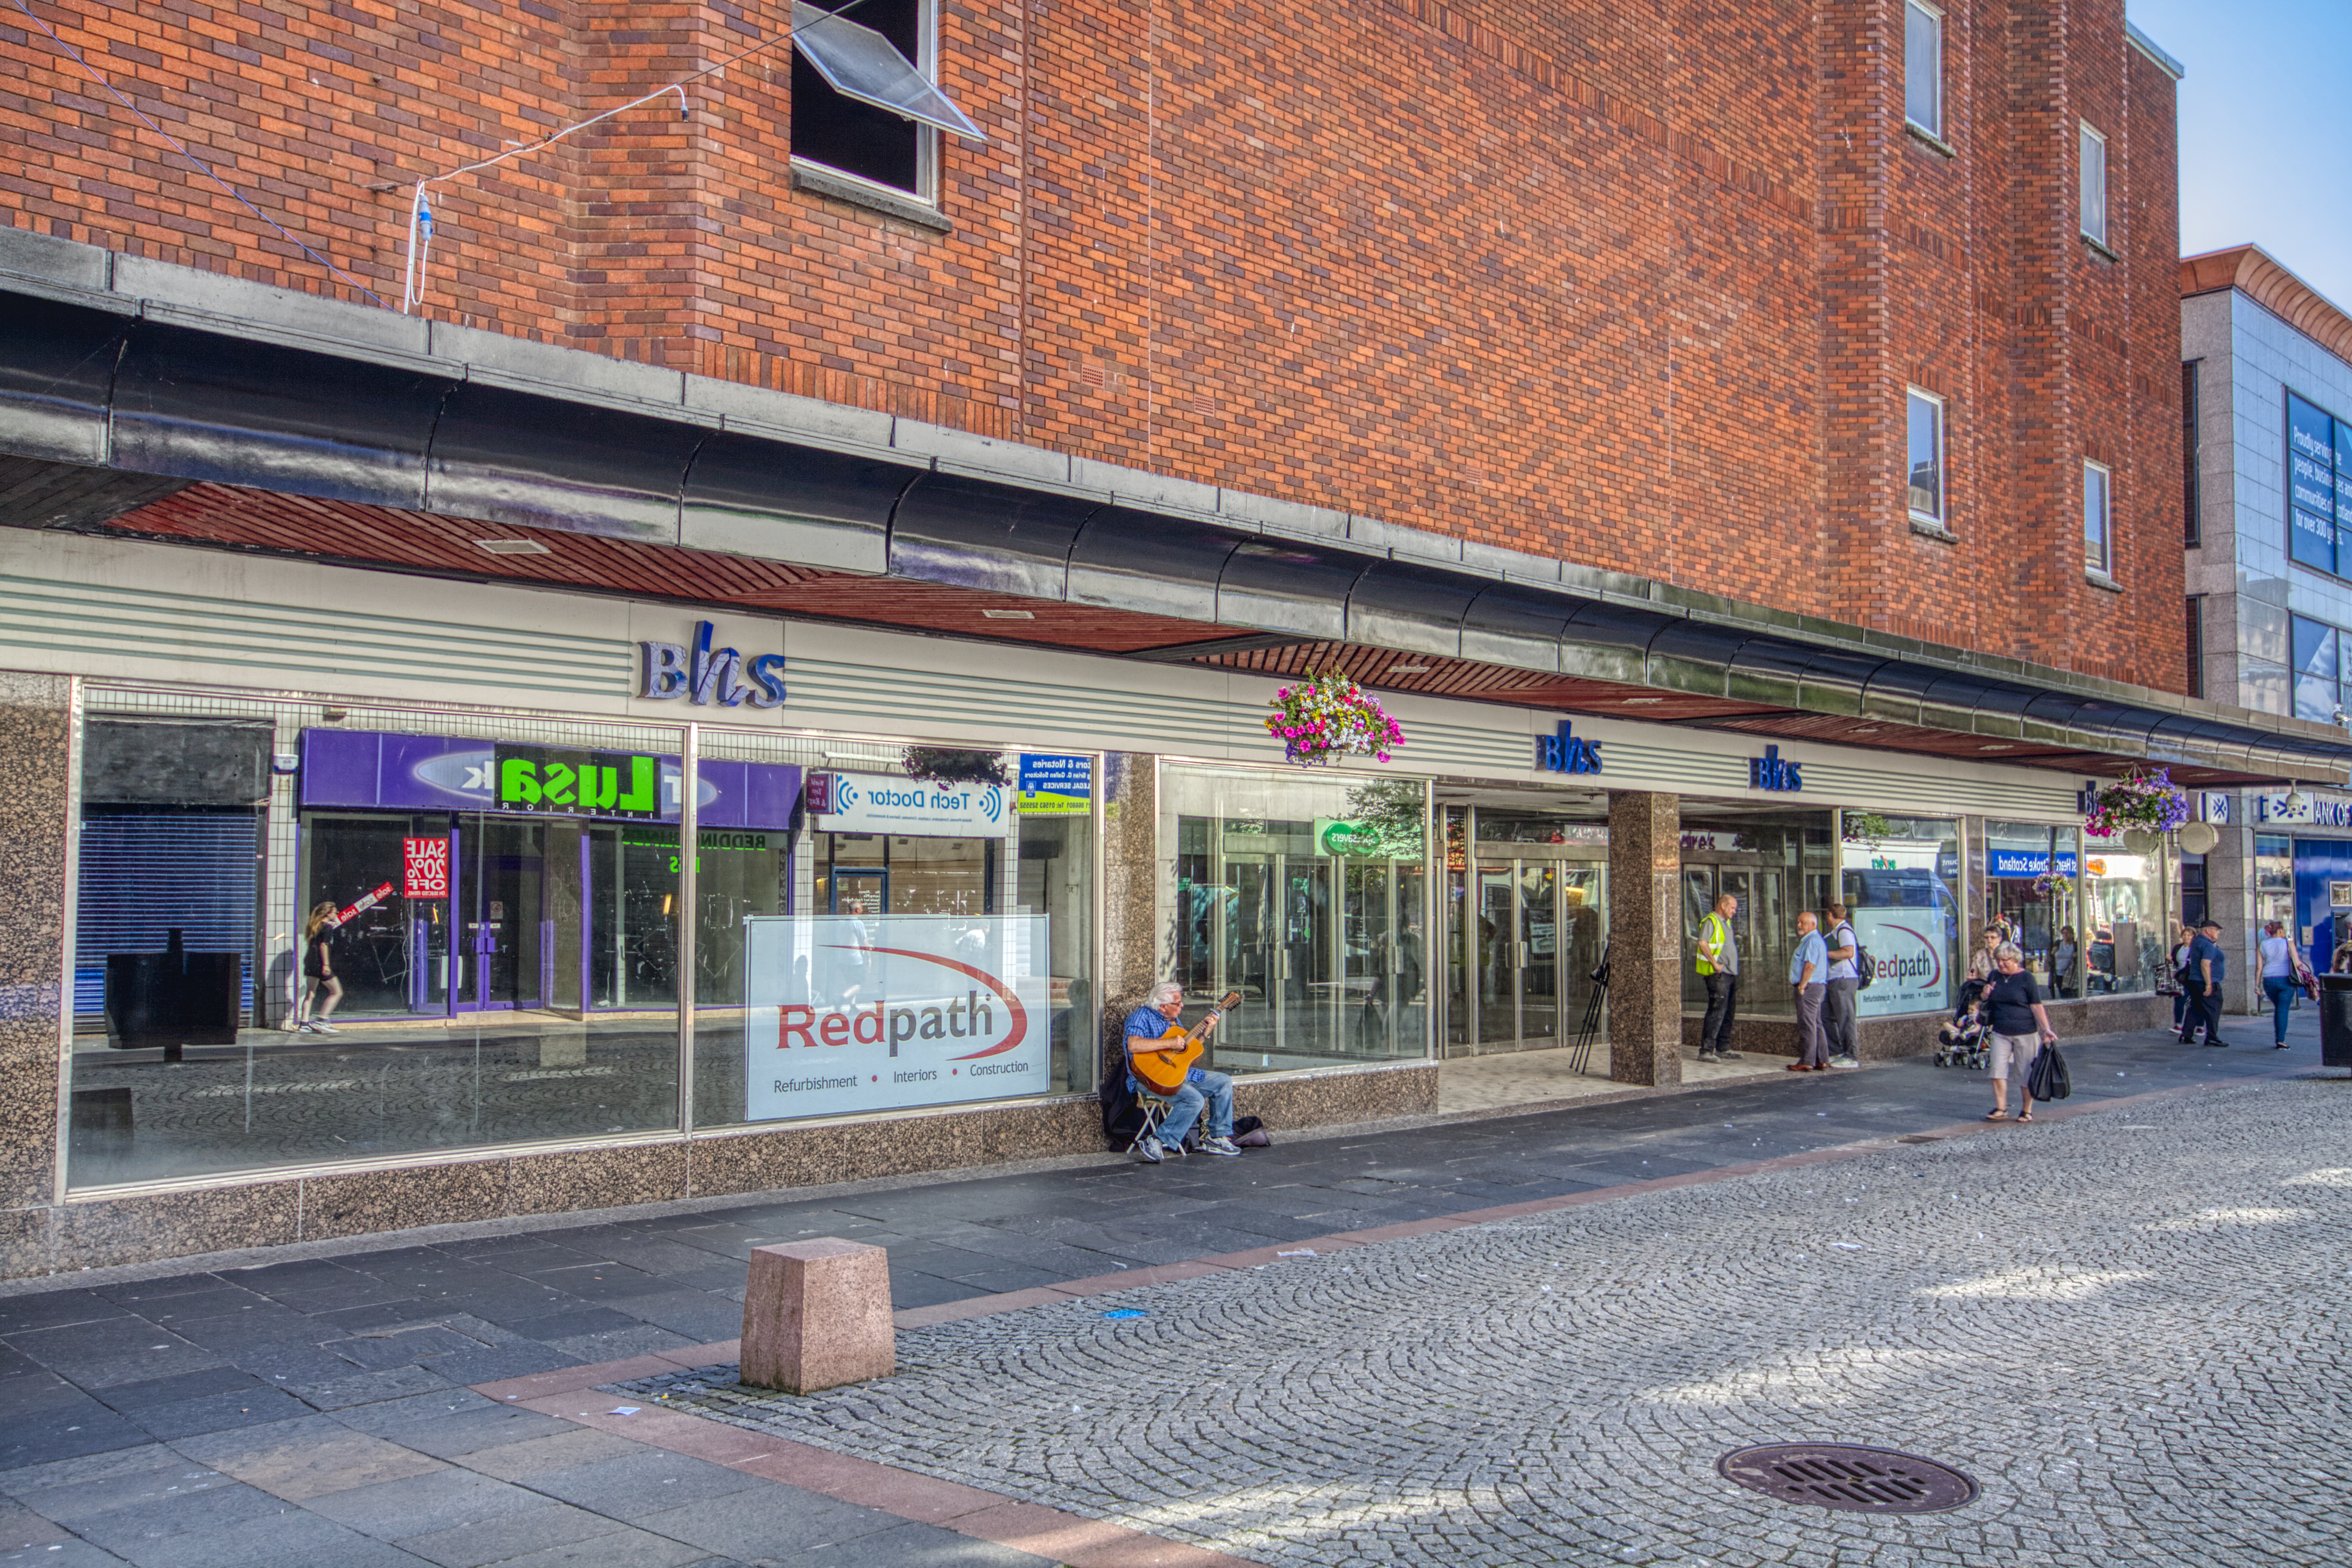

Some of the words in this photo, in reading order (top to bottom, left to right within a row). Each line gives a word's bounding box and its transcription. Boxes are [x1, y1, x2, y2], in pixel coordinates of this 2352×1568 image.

[2294, 426, 2314, 456] Proudly
[2314, 441, 2332, 465] serving
[2294, 457, 2314, 481] people,
[2295, 484, 2327, 512] communities
[2304, 516, 2316, 534] over
[2316, 517, 2326, 538] 300
[2327, 525, 2344, 545] yers.
[637, 620, 787, 709] Bhs
[1534, 720, 1603, 775] Bhs
[1749, 744, 1802, 792] Bhs
[2315, 801, 2336, 826] ANK
[1873, 950, 1930, 985] edpath
[776, 990, 992, 1057] Redpath
[774, 1075, 858, 1093] Refurbishment
[893, 1069, 937, 1083] Interiors
[970, 1061, 1029, 1076] Construction
